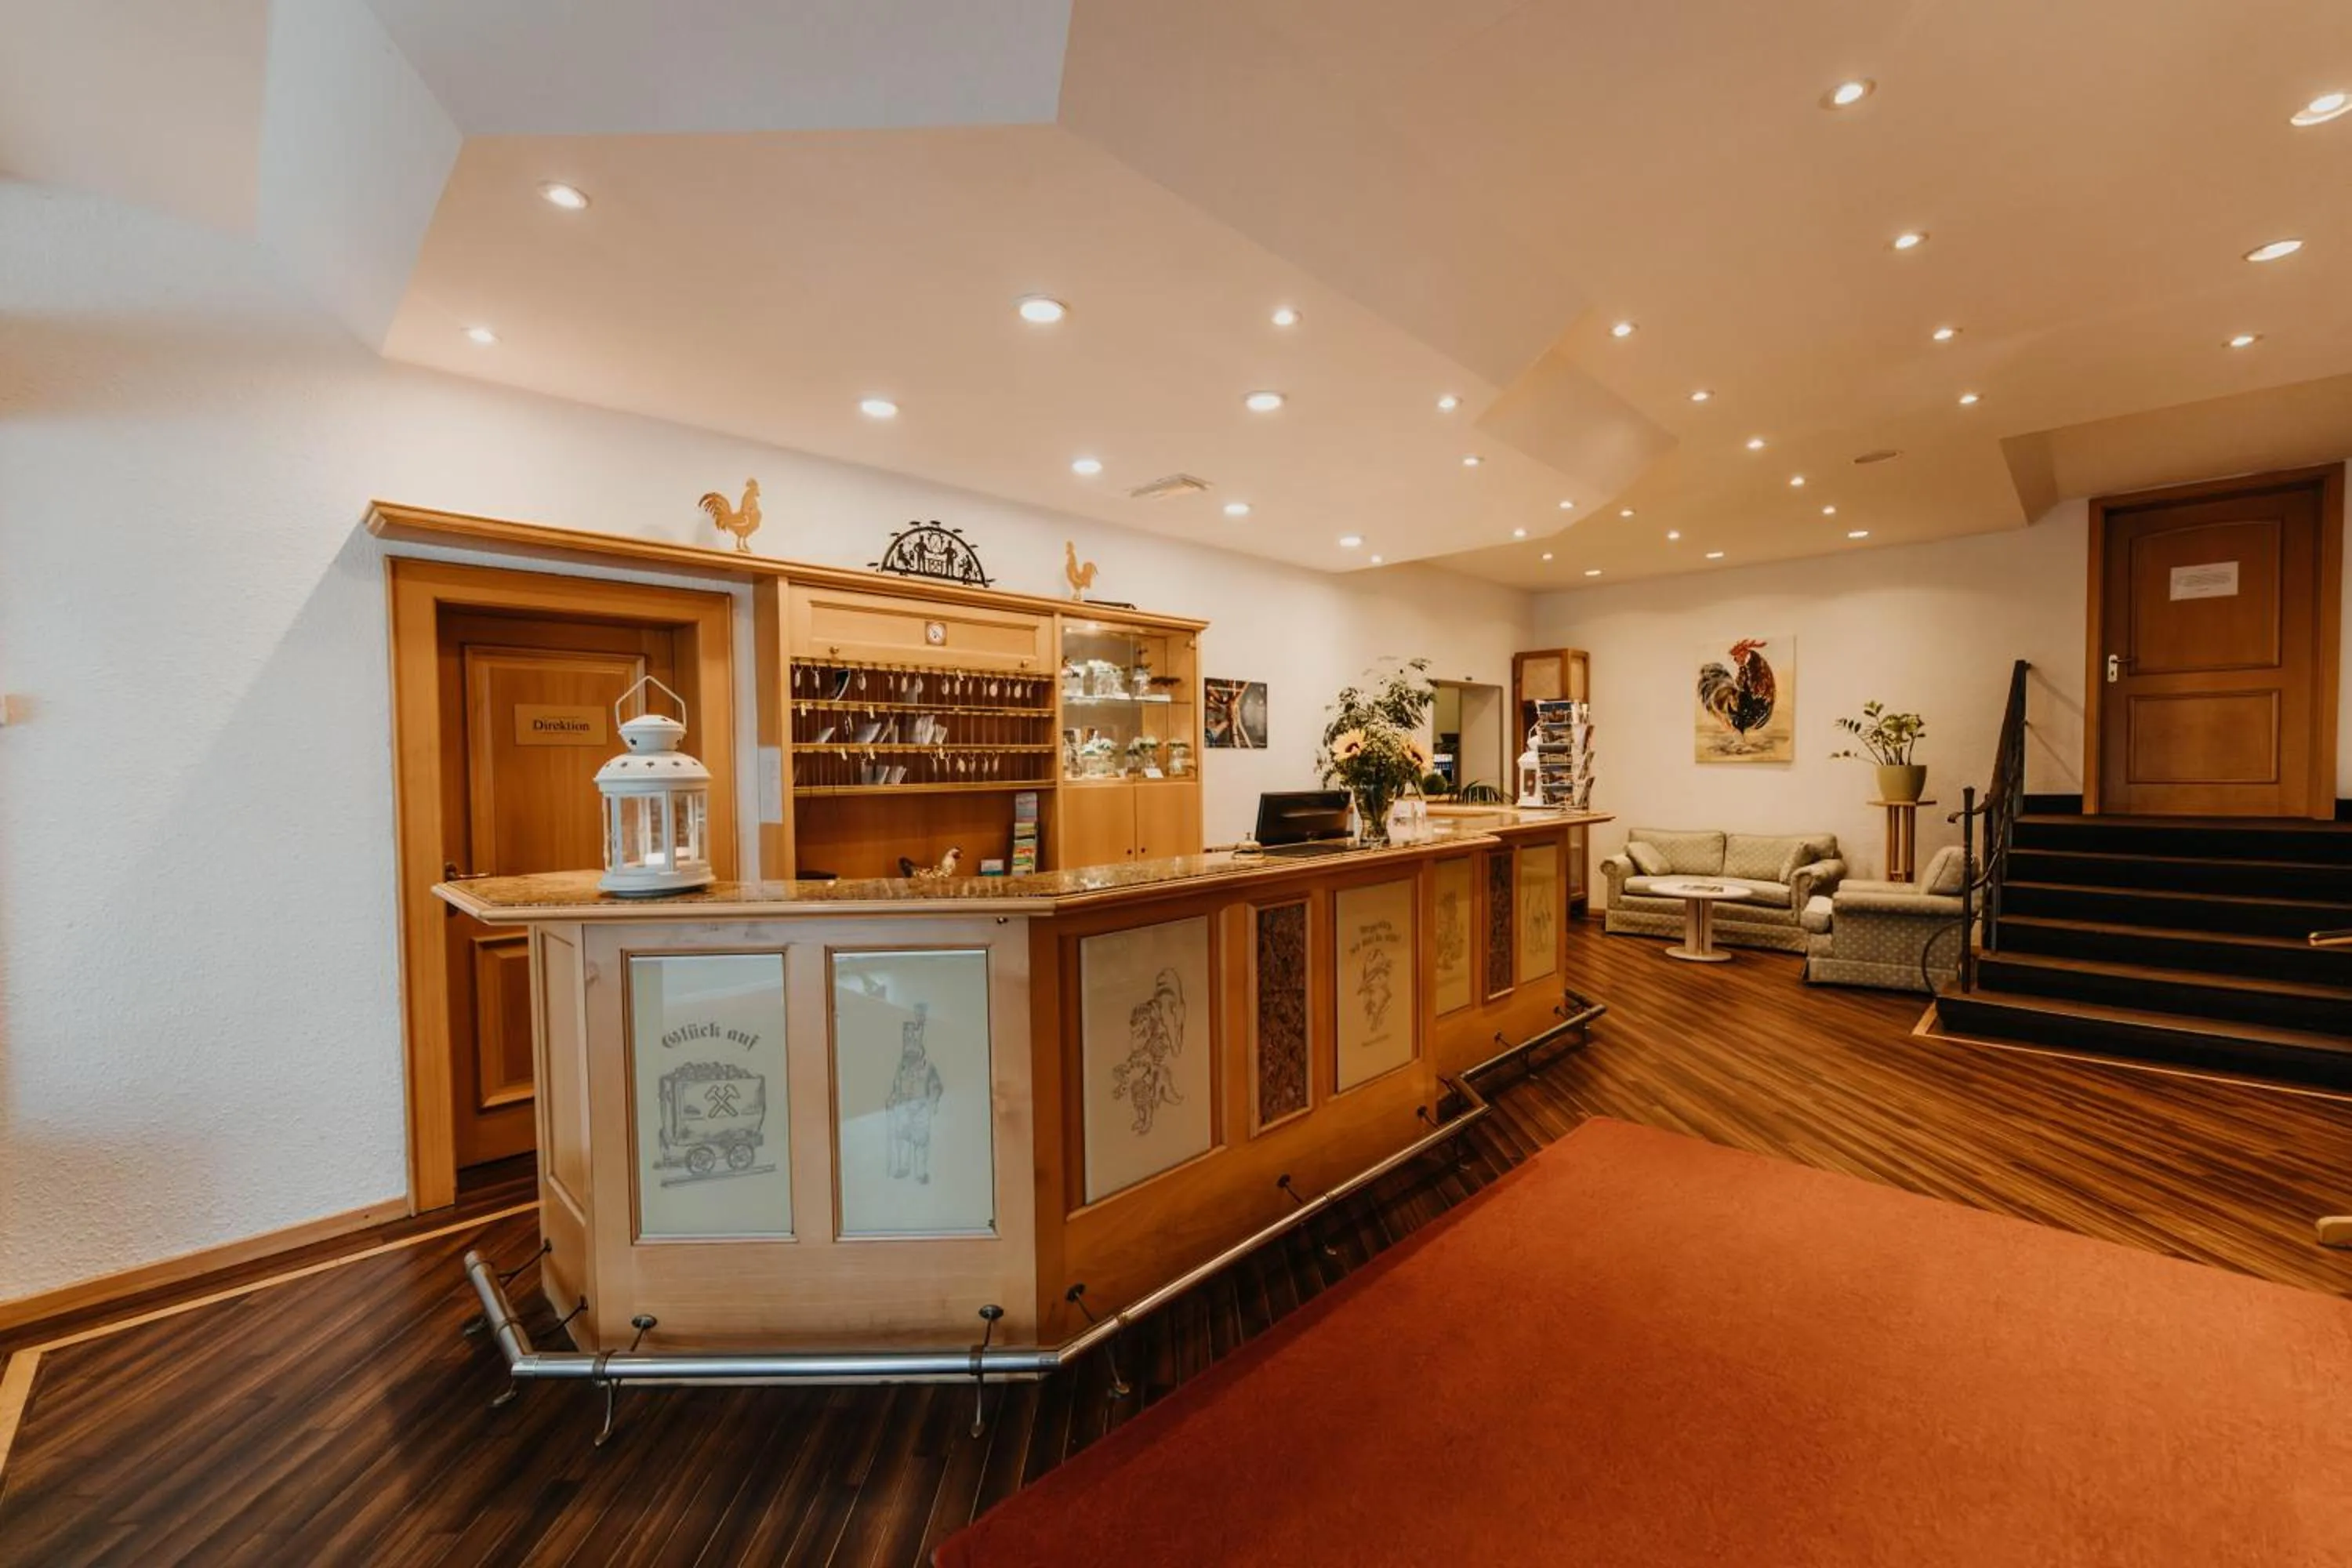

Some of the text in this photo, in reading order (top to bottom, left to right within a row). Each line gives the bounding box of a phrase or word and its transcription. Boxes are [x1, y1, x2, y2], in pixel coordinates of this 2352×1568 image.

[532, 718, 590, 731] Direktion
[661, 1022, 760, 1052] Glück auf
